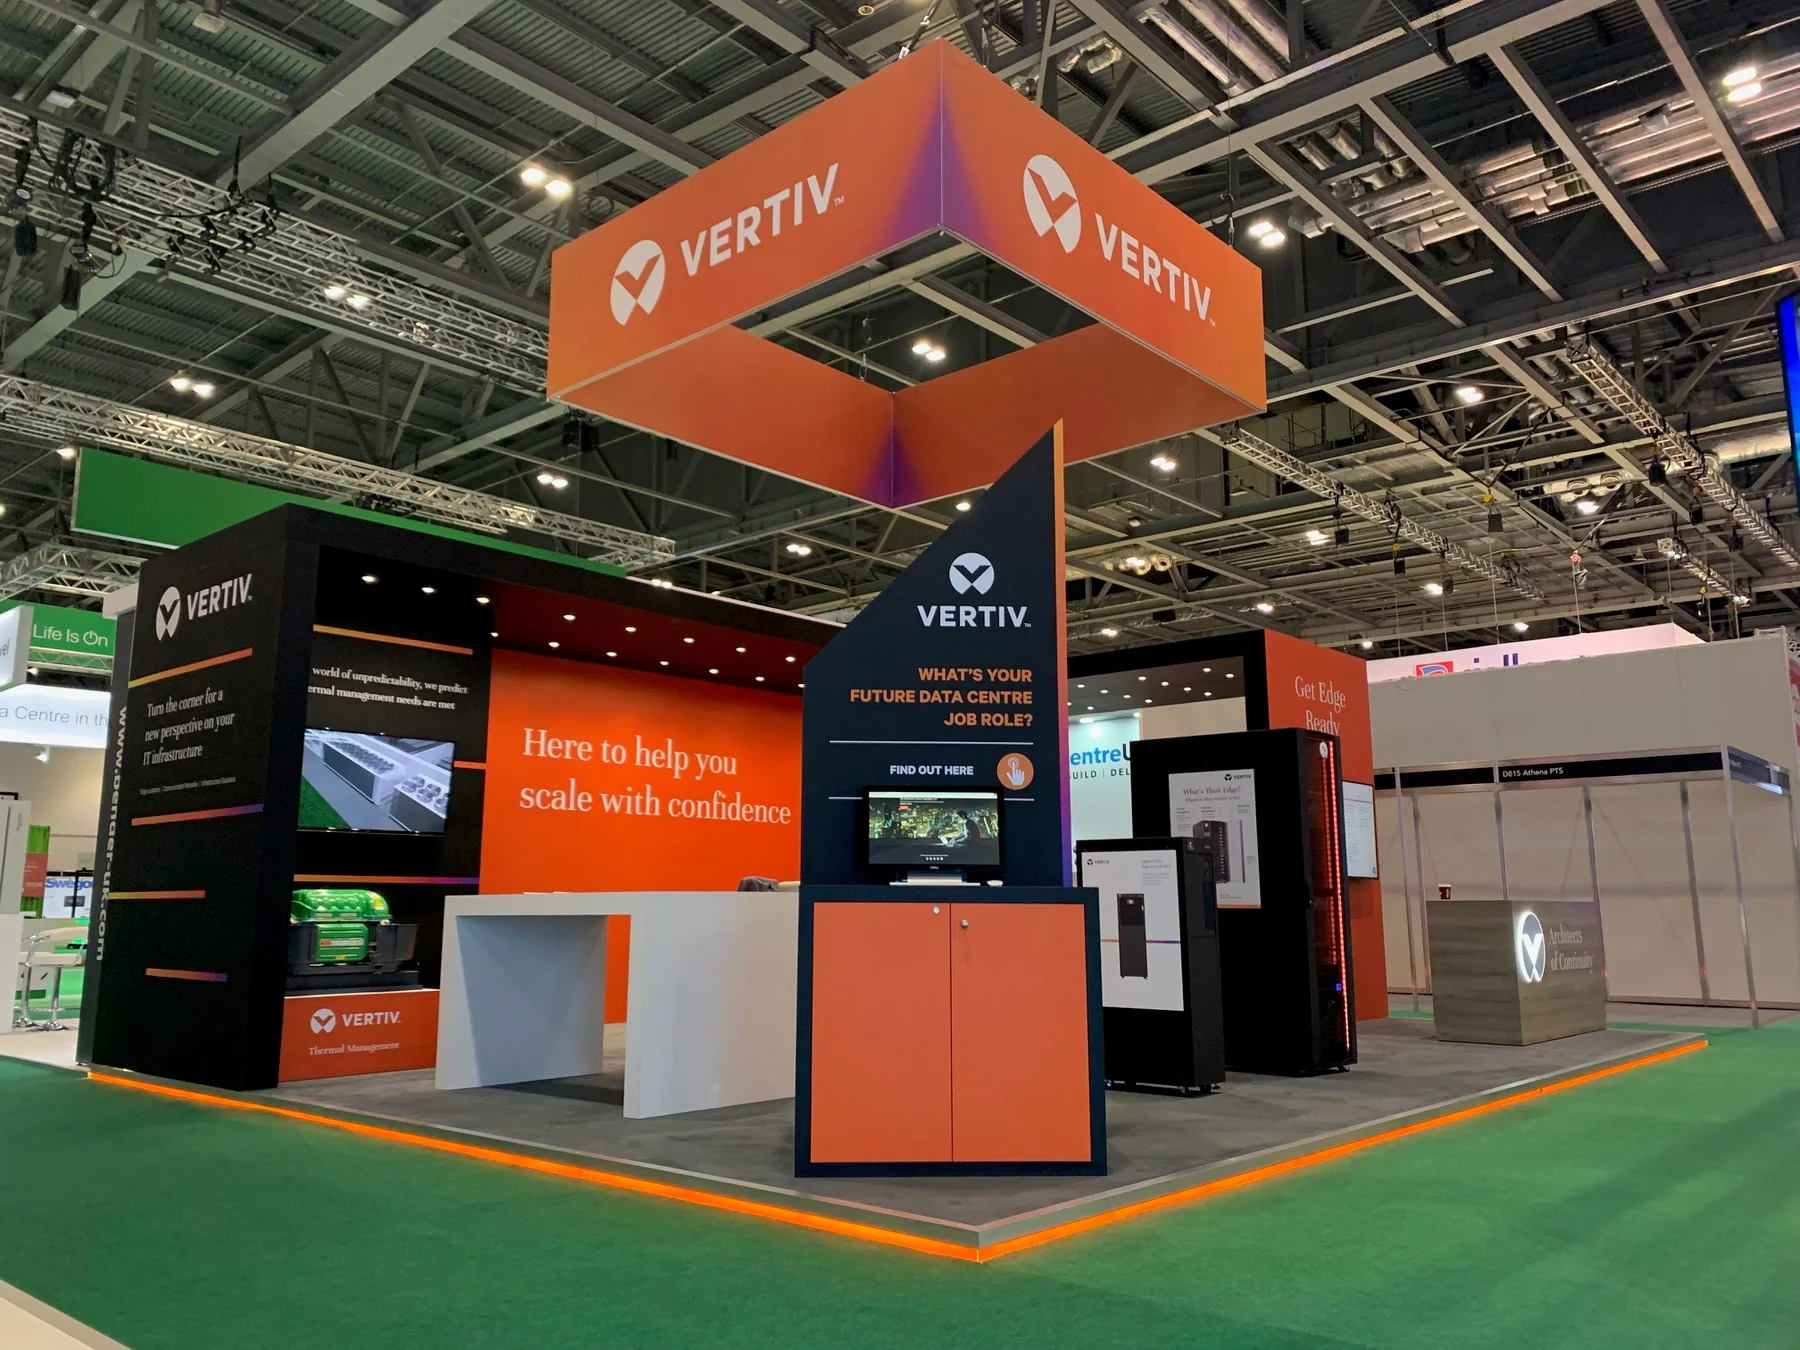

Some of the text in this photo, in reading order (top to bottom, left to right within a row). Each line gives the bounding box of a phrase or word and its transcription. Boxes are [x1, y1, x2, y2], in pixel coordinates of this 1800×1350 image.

[680, 162, 839, 277] VERTIV
[1094, 212, 1212, 321] VERTIV
[187, 573, 252, 620] VERTIV
[917, 605, 1028, 627] VERTIV
[33, 624, 108, 647] Life Is On
[312, 667, 469, 694] world of unpredictability, we predict
[918, 667, 1032, 682] WHAT'S YOUR
[147, 686, 224, 717] Turn the corner for a
[336, 688, 394, 702] management
[396, 695, 421, 706] needs
[422, 699, 437, 708] are
[438, 701, 455, 710] met
[850, 689, 1033, 704] FUTURE DATA CENTRE
[1295, 675, 1347, 713] Get Edge
[15, 706, 70, 723] Centre
[75, 713, 89, 724] in
[944, 712, 1033, 727] JOB ROLE?
[1305, 709, 1340, 736] Ready
[145, 713, 236, 743] new perspective on your
[143, 745, 203, 766] IT infrastructure
[523, 727, 737, 780] Here to help you
[890, 765, 974, 776] FIND OUT HERE
[1070, 770, 1097, 780] UILD
[1502, 770, 1521, 778] D815
[519, 778, 791, 825] scale with confidence
[1550, 923, 1584, 945] Architects
[342, 1010, 401, 1027] VERTIV
[308, 1041, 400, 1056] Thermal Management
